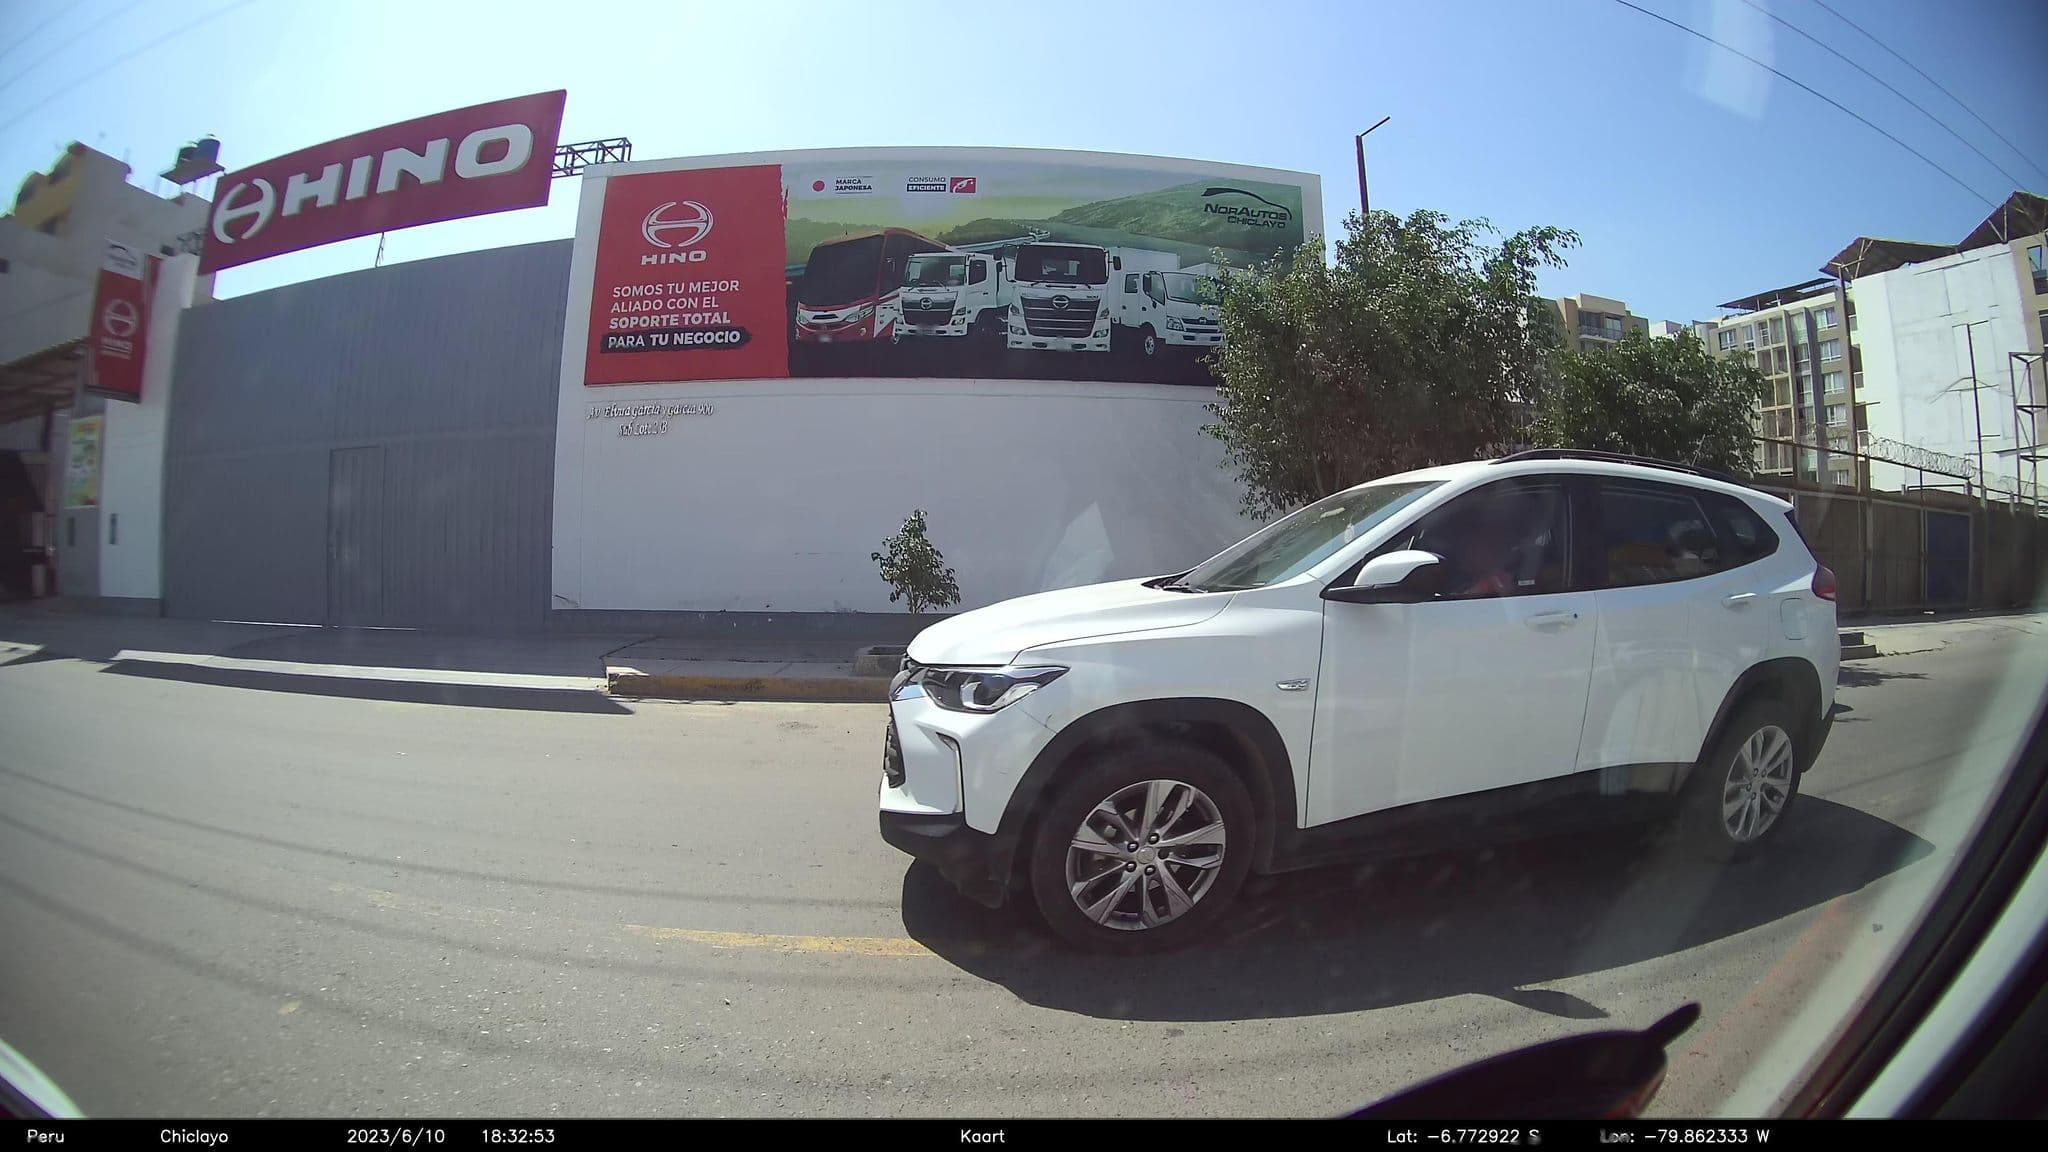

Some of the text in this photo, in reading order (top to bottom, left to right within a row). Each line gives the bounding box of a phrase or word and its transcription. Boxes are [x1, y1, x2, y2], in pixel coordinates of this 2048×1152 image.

[281, 123, 534, 217] HINO
[908, 184, 945, 192] EFICIENTE
[1227, 216, 1286, 228] CHICLAYO
[641, 250, 707, 265] HINO
[613, 280, 740, 298] SOMOS TU MEJOR
[611, 296, 719, 313] ALIADO CON EL
[609, 311, 731, 329] SOPORTE TOTAL
[608, 331, 741, 349] PARA TU NEGOCIO
